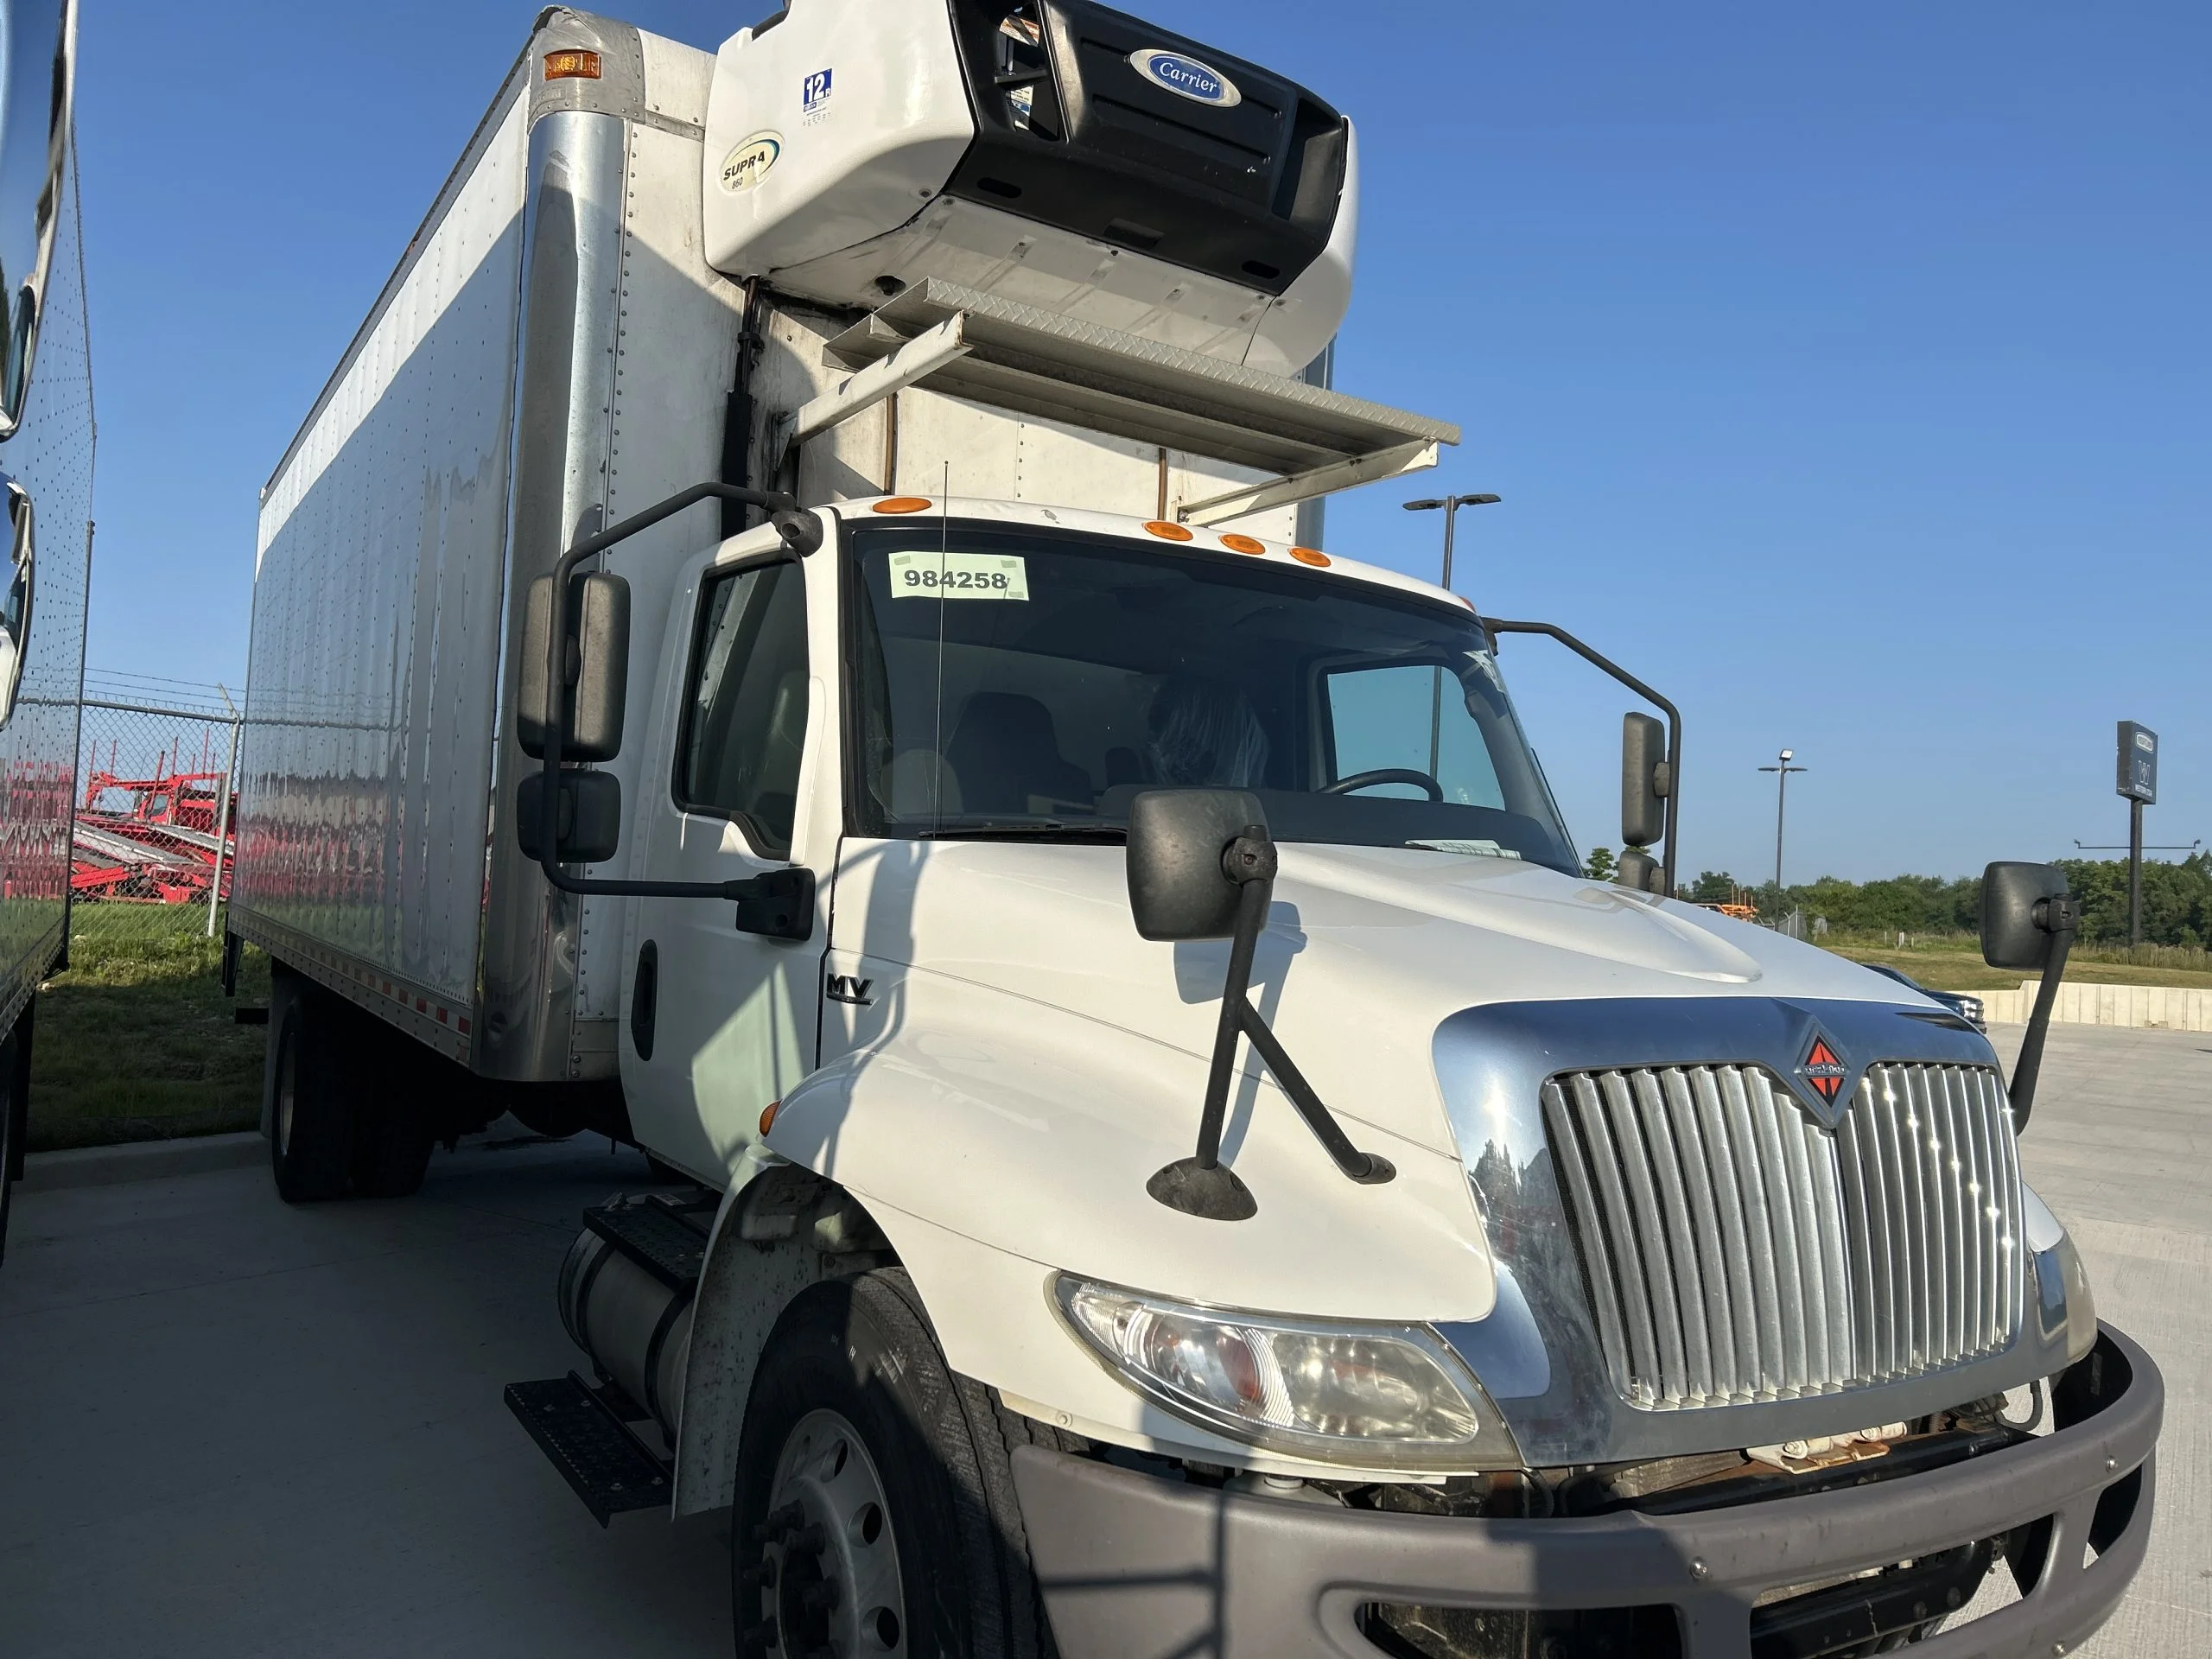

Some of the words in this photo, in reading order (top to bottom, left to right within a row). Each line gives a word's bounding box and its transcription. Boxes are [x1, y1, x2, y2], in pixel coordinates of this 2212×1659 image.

[1159, 62, 1217, 92] Carrier
[904, 569, 1008, 589] 984258
[826, 972, 874, 999] MV
